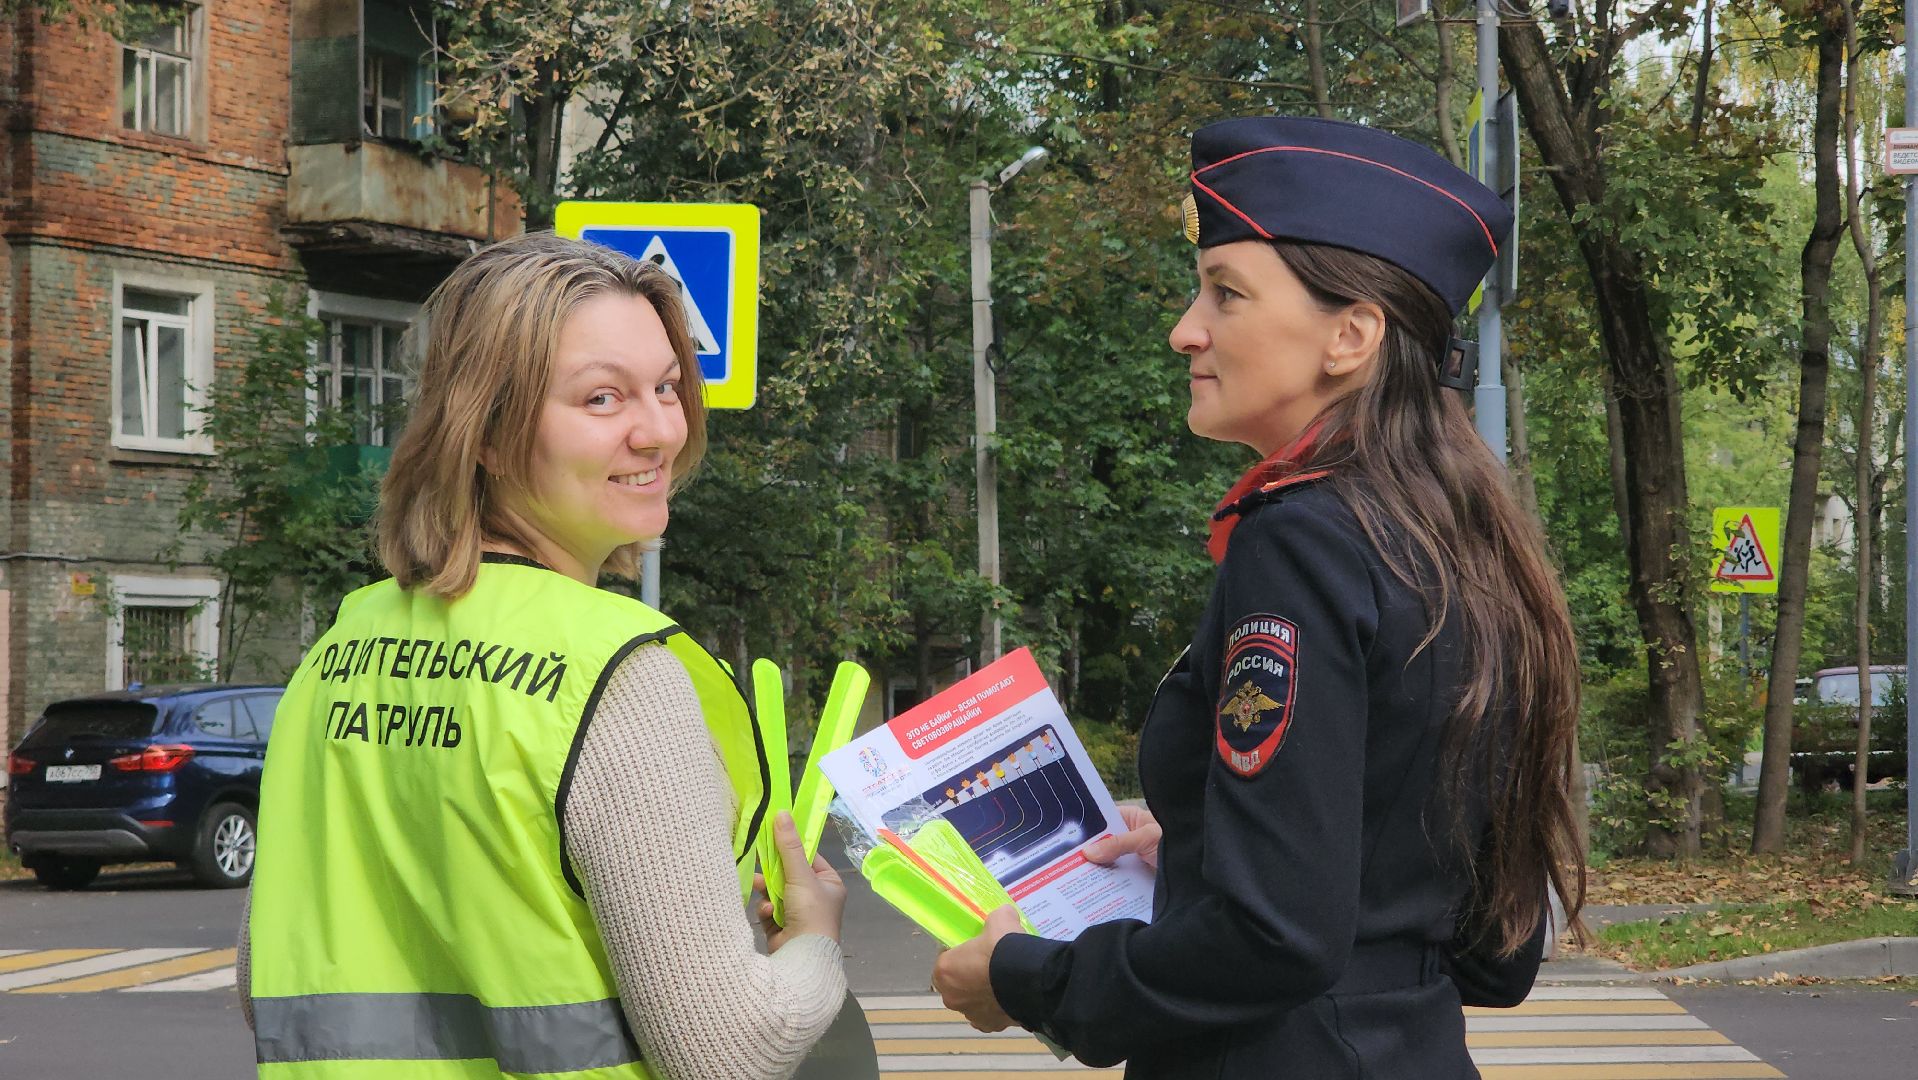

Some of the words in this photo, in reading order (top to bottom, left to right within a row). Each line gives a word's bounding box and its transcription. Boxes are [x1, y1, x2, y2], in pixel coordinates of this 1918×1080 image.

[1228, 620, 1290, 650] ПОЛИЦИЯ
[1227, 654, 1284, 686] РОССИЯ
[325, 701, 462, 748] ПАТРУЛЬ
[906, 727, 921, 740] ЭТО
[920, 722, 930, 732] НЕ
[929, 710, 952, 728] БАЙКИ
[957, 696, 978, 711] ВСЕМ
[976, 675, 1015, 702] ПОМОГАЮТ
[912, 706, 982, 750] СВЕТОВОЗВРАЩАЙКИ
[1231, 750, 1260, 772] МВД
